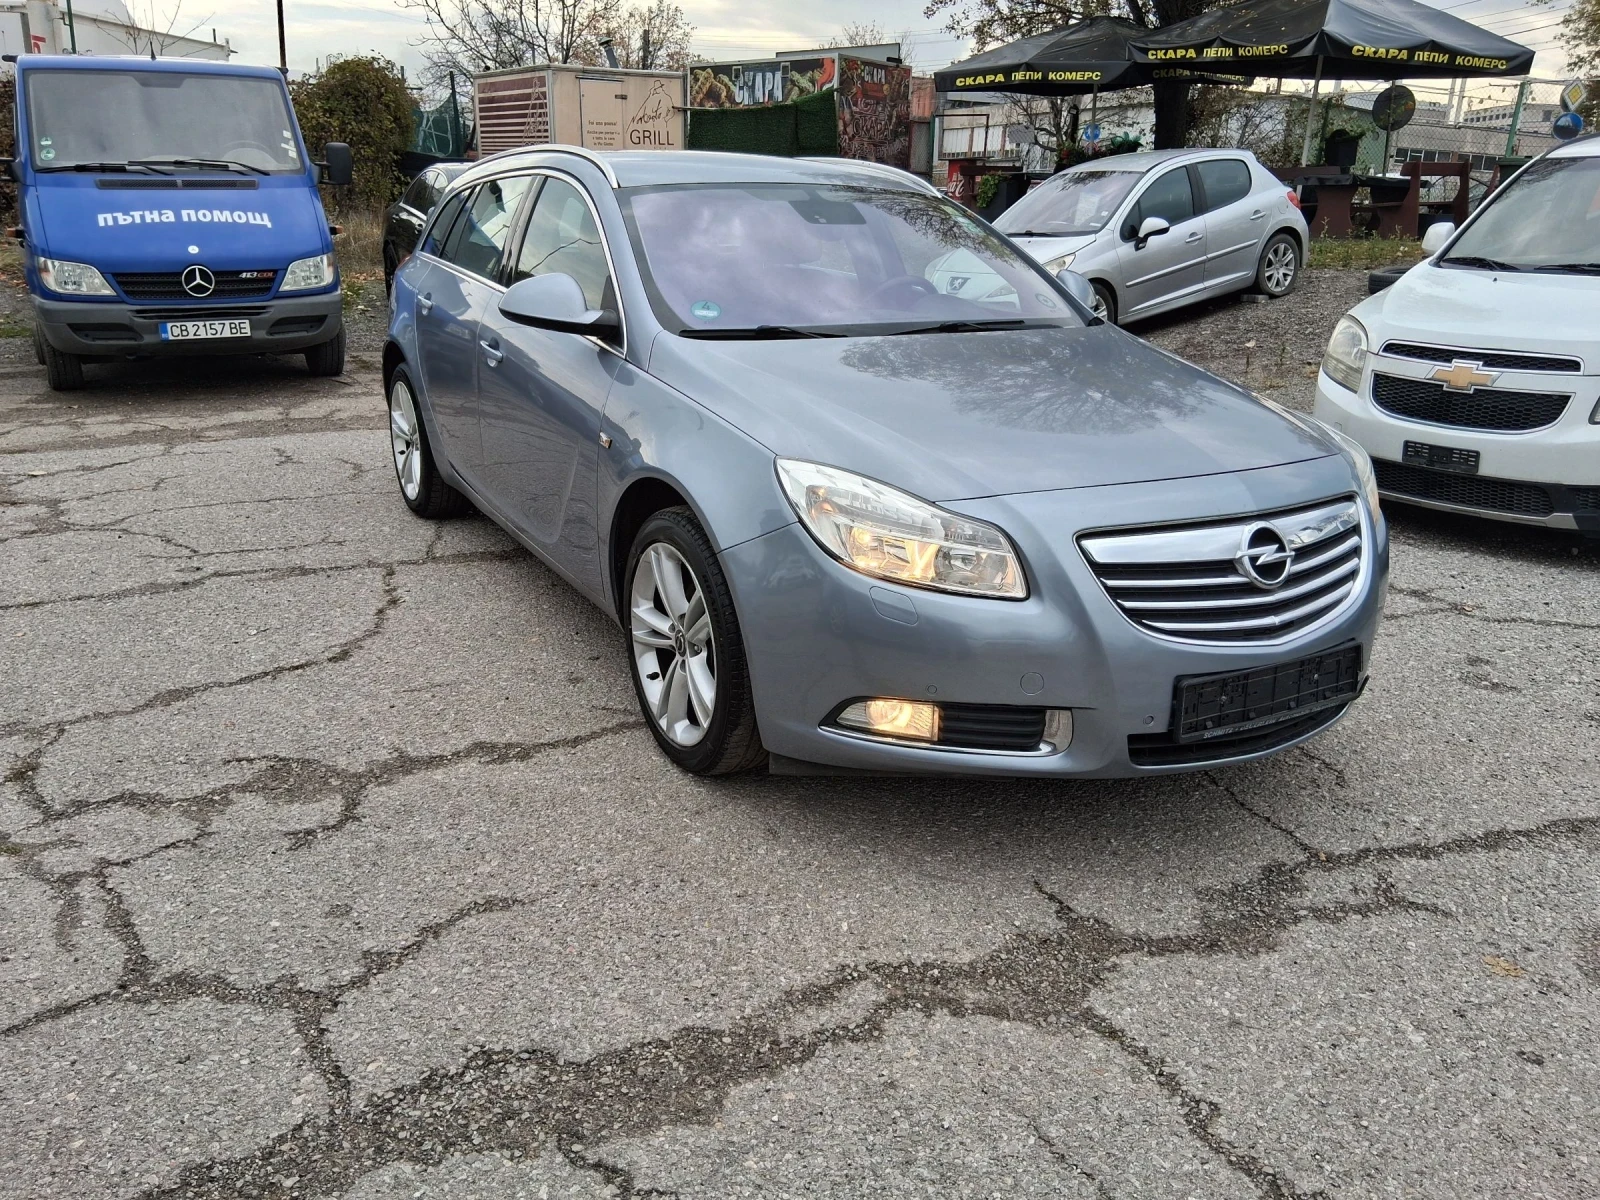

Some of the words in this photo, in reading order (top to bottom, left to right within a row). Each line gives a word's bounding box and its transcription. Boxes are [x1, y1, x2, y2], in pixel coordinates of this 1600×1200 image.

[1148, 48, 1196, 59] СКАРА
[1203, 47, 1233, 57] ПЕПИ
[1238, 44, 1288, 56] КОМЕРС
[1351, 45, 1408, 60] СКАРА
[1414, 51, 1449, 63] ПЕПИ
[1455, 55, 1507, 69] КОМЕРС
[955, 73, 1005, 86] СКАРА
[1011, 71, 1042, 81] ПЕПИ
[1048, 71, 1101, 80] КОМЕРС
[1152, 68, 1191, 79] СКАРА
[734, 71, 783, 105] СКАРА
[629, 129, 674, 146] GRILL
[97, 209, 176, 226] пътна
[181, 209, 272, 228] помощ
[170, 324, 189, 338] CB
[192, 322, 226, 337] 2157
[229, 321, 248, 335] BE
